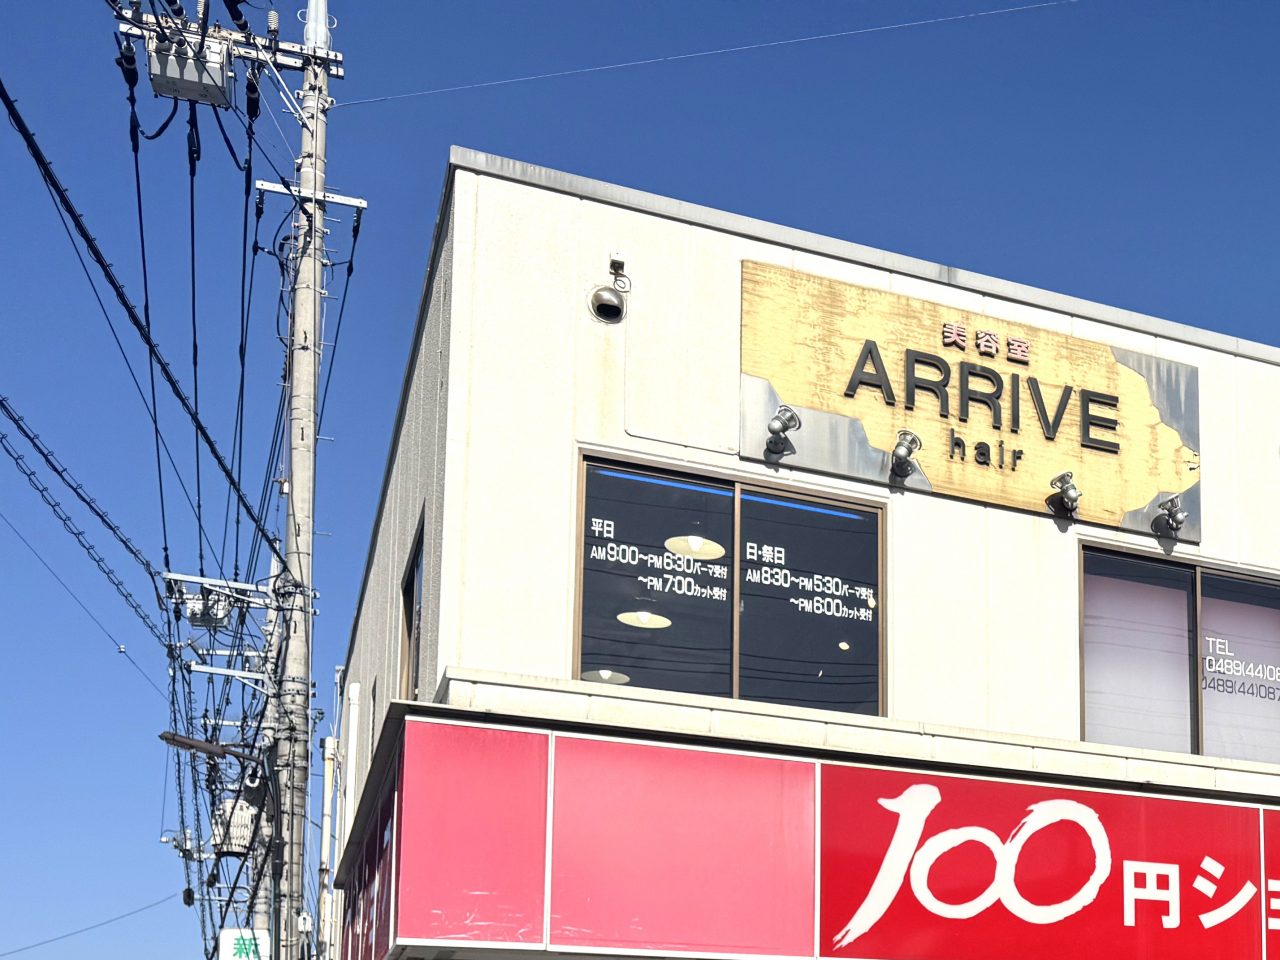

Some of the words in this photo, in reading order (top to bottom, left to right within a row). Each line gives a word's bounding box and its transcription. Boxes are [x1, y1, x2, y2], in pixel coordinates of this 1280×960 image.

[943, 323, 1030, 365] 美容室
[844, 339, 1120, 454] ARRIVE
[950, 428, 1024, 470] hair
[591, 518, 614, 538] 平日
[1205, 636, 1234, 656] TEL
